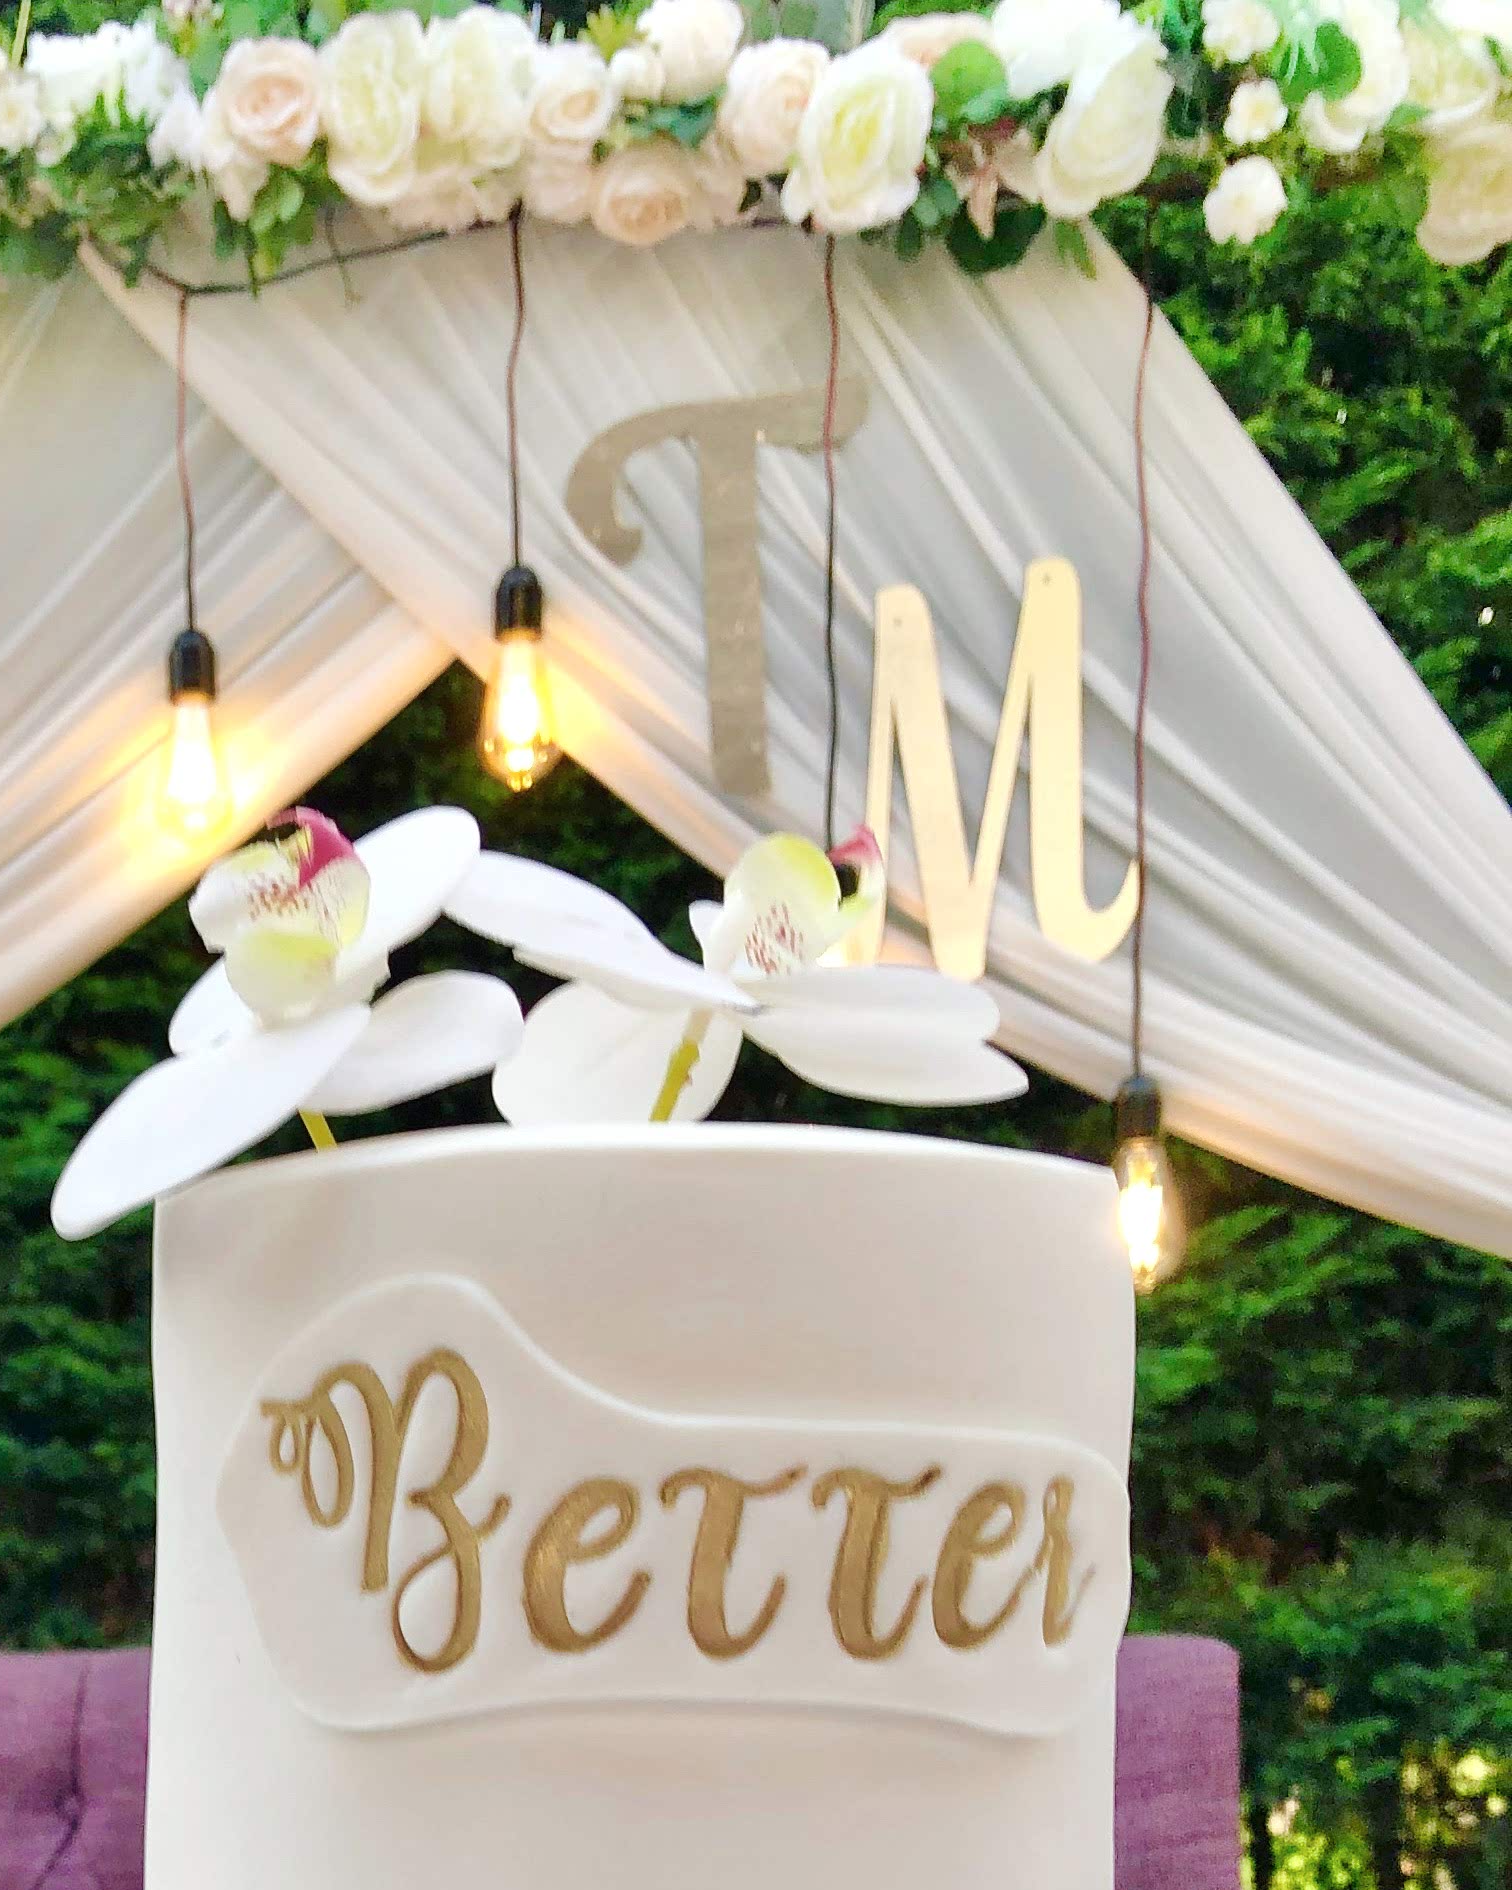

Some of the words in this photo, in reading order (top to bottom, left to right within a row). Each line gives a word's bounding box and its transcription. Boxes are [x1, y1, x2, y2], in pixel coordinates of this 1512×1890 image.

[566, 376, 870, 798] T
[848, 555, 1139, 982] M
[261, 1345, 1096, 1674] Better
